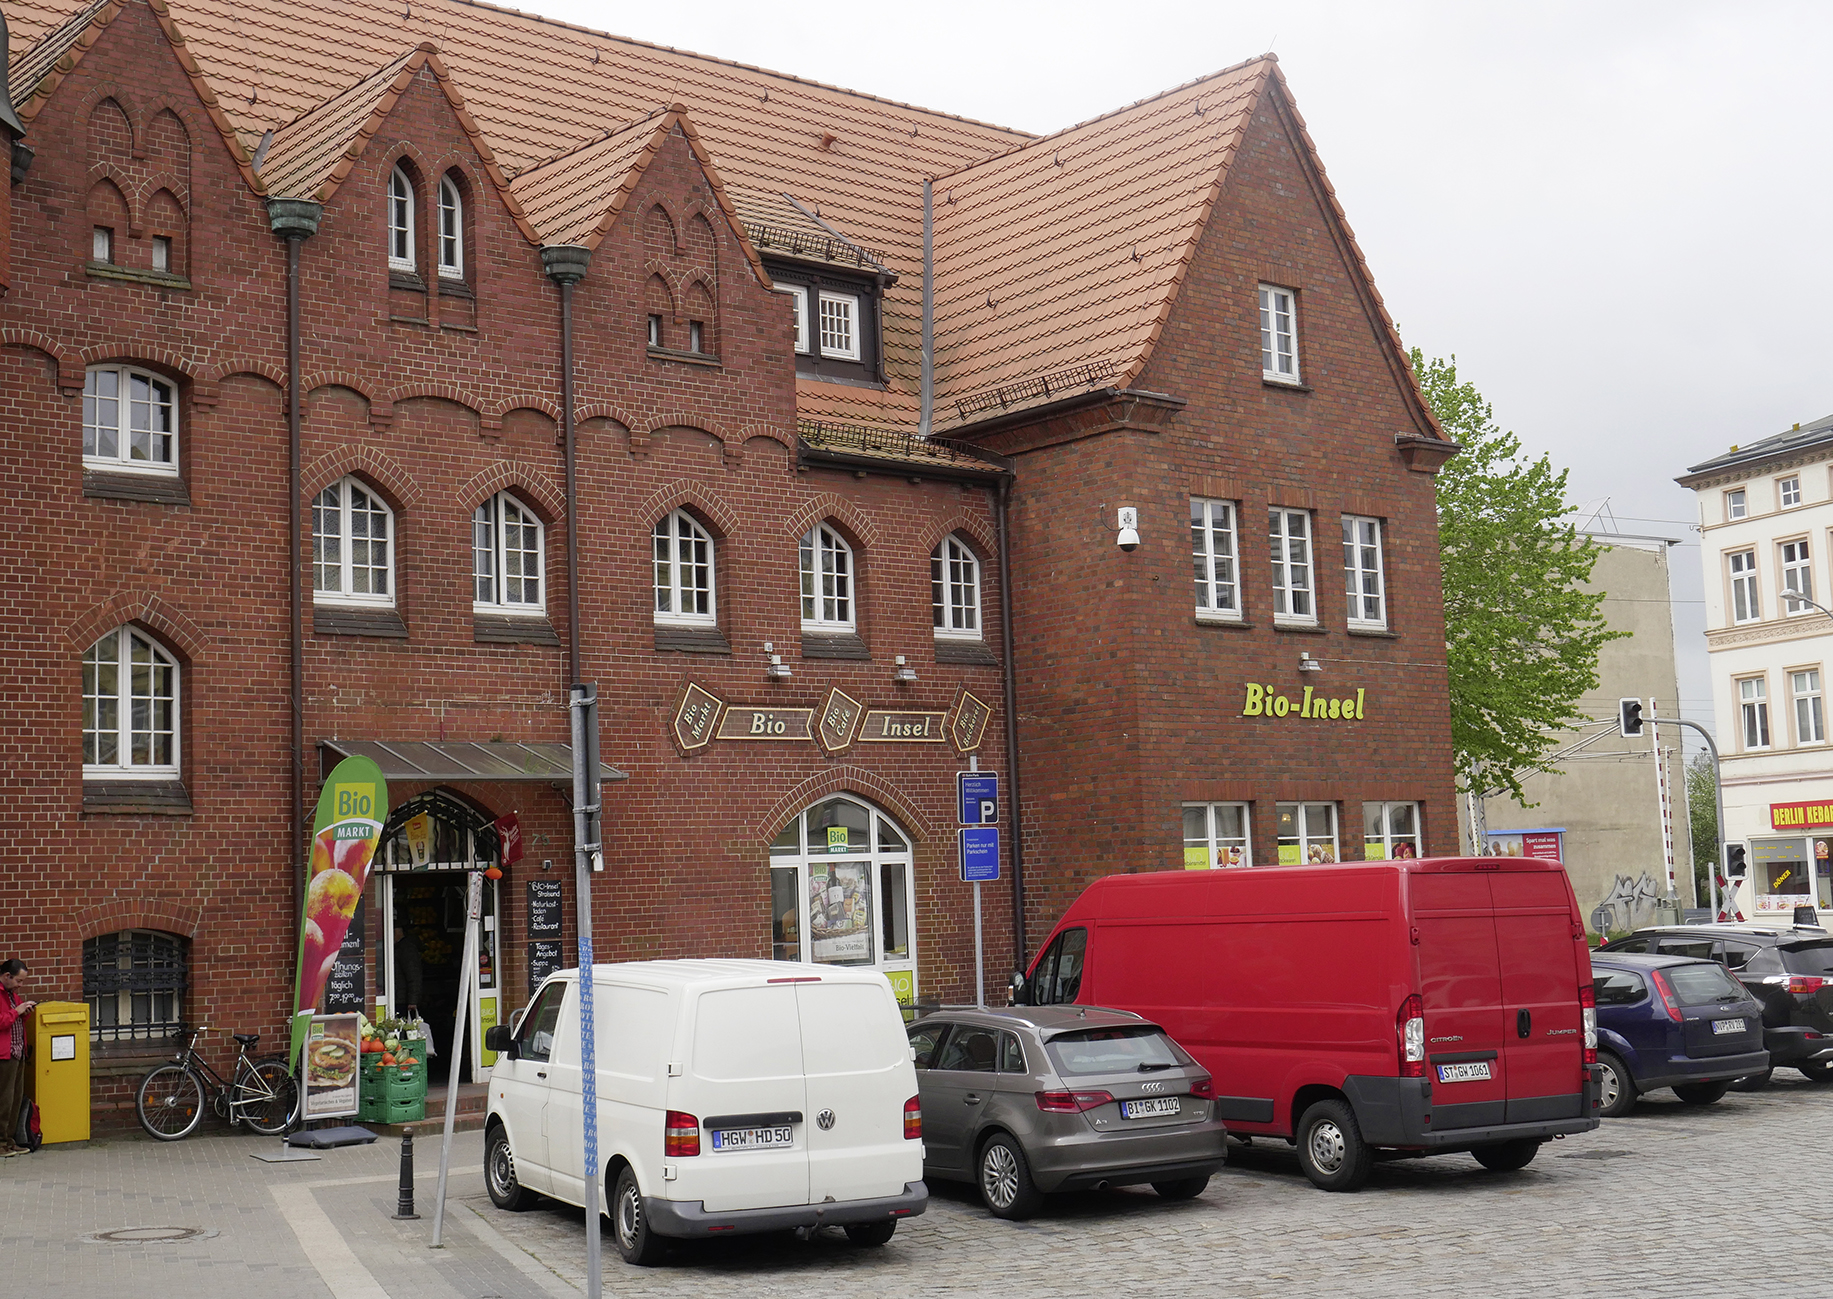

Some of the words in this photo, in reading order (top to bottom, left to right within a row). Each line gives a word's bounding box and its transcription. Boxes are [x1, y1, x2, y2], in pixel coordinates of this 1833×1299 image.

[1243, 682, 1364, 720] Bio-Insel
[684, 704, 697, 725] Bio
[692, 702, 711, 740] Markt
[750, 712, 786, 734] Bio
[882, 716, 930, 736] Insel
[827, 708, 840, 728] Bio
[836, 710, 850, 736] Café
[960, 713, 968, 729] Bio
[338, 790, 371, 816] Bio
[982, 801, 994, 822] P
[1773, 807, 1805, 825] BERLIN
[338, 826, 370, 838] MARKT
[532, 833, 550, 846] 75
[830, 830, 846, 842] Bio
[1773, 869, 1791, 888] DÖNER
[1444, 1066, 1453, 1078] ST
[1458, 1066, 1468, 1077] GW
[1470, 1065, 1489, 1076] 1061
[1128, 1102, 1139, 1114] BI
[1144, 1100, 1158, 1112] GK
[1158, 1098, 1179, 1111] 1102
[722, 1132, 747, 1146] HGW
[756, 1130, 772, 1143] HD
[775, 1129, 791, 1142] 50
